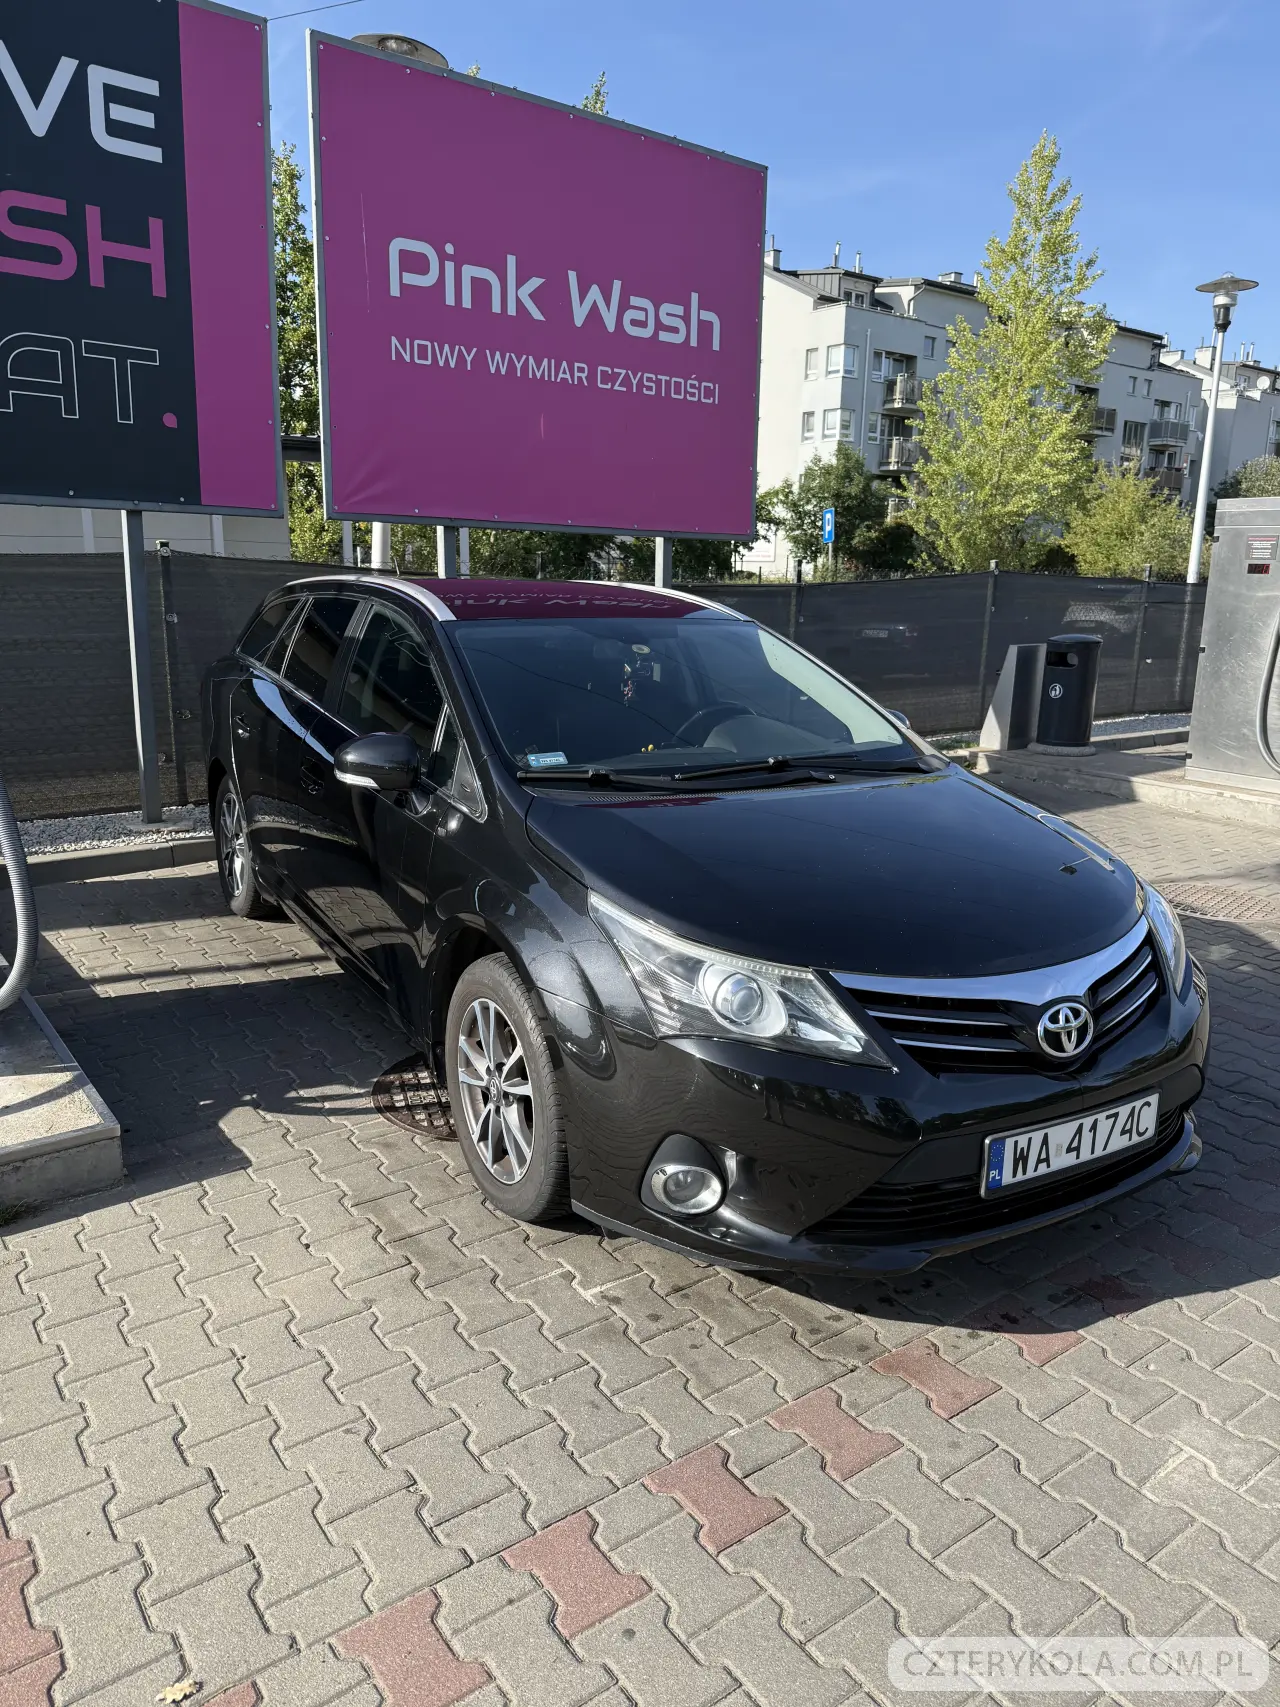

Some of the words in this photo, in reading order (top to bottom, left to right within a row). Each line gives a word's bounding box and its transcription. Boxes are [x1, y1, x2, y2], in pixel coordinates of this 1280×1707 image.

[0, 39, 163, 163] VE
[0, 189, 167, 298] SH
[388, 236, 547, 322] Pink
[567, 269, 721, 352] Wash
[390, 335, 478, 371] NOWY
[485, 348, 589, 387] WYMIAR
[596, 364, 720, 405] CZYSTOŚCI
[825, 513, 831, 538] P
[989, 1168, 1001, 1182] PL
[1012, 1132, 1051, 1179] WA
[1065, 1100, 1152, 1161] 4174C
